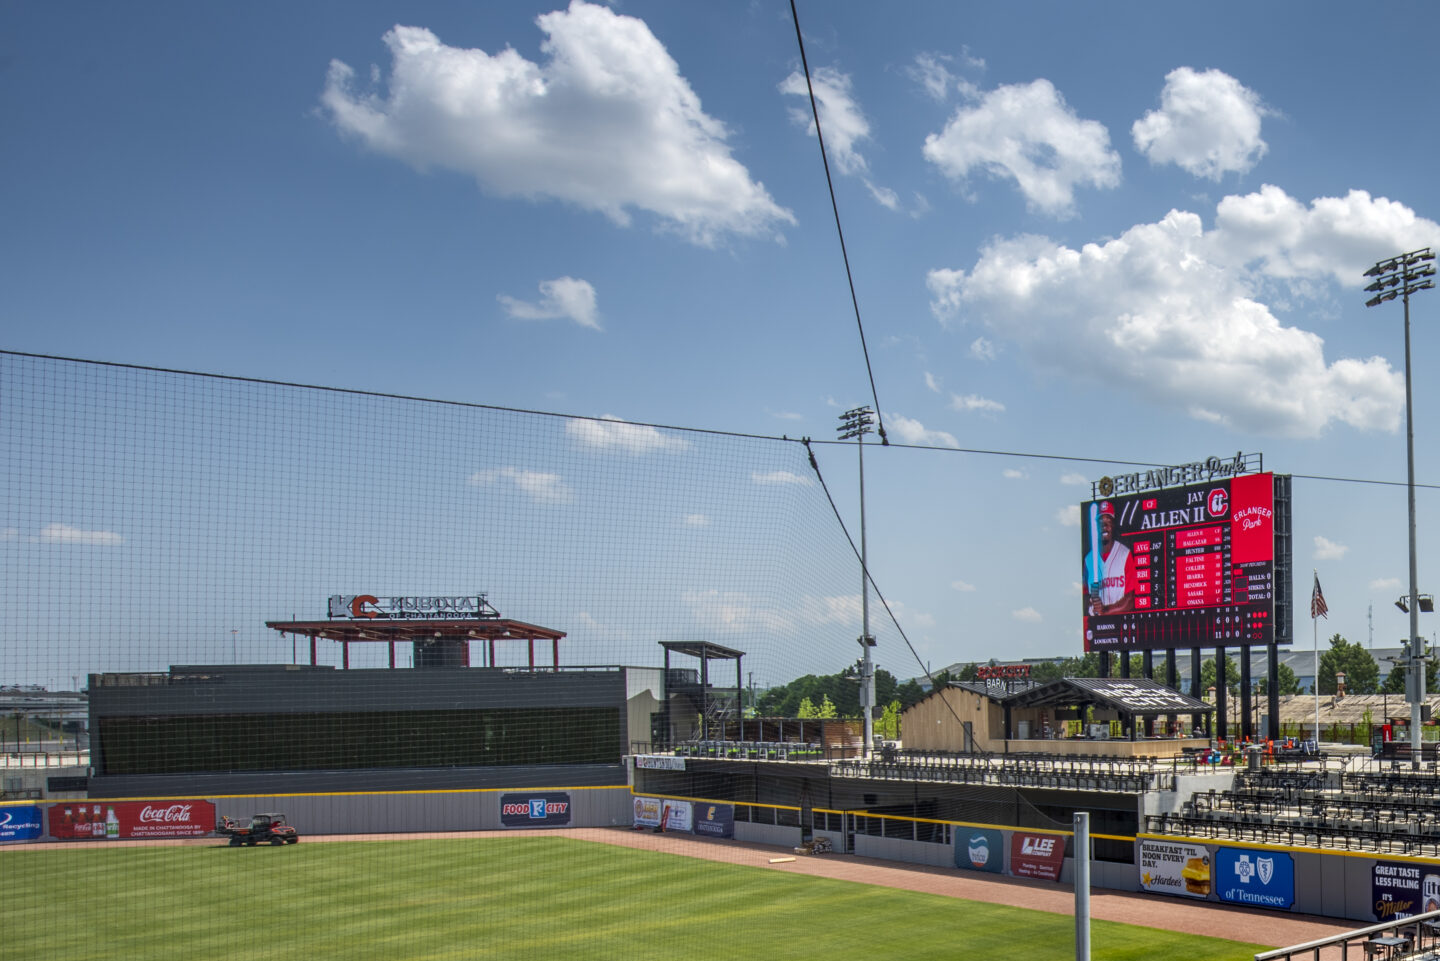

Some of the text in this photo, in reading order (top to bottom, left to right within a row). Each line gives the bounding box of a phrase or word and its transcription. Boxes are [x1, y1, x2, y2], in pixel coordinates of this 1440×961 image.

[1112, 451, 1247, 494] ERLANGER Park
[1146, 500, 1155, 508] CF
[1187, 491, 1204, 505] JAY
[1141, 506, 1206, 530] ALLEN II
[1233, 506, 1273, 522] ERLANGER
[1242, 515, 1263, 532] Park
[1136, 544, 1149, 552] AVG
[1137, 557, 1147, 565] HR
[1136, 570, 1148, 578] RBI
[389, 597, 474, 611] KUBOTA
[1138, 598, 1147, 606] SB
[1215, 631, 1222, 639] 11
[977, 664, 1032, 679] ROCK CITY
[986, 678, 1007, 691] BARN
[140, 805, 192, 822] Coca-Cola
[503, 802, 568, 815] FOOD CITY
[1035, 838, 1056, 851] LEE
[1142, 844, 1198, 857] BREAKFAST 'TIL
[1142, 852, 1185, 863] NOON EVERY
[1142, 860, 1158, 868] DAY.
[1375, 865, 1420, 878] GREAT TASTE
[1151, 874, 1182, 887] Hardee's
[1375, 877, 1420, 889] LESS FILLING
[1225, 888, 1285, 906] of Tennessee
[1382, 893, 1393, 901] IT'S
[1375, 900, 1414, 918] Miller
